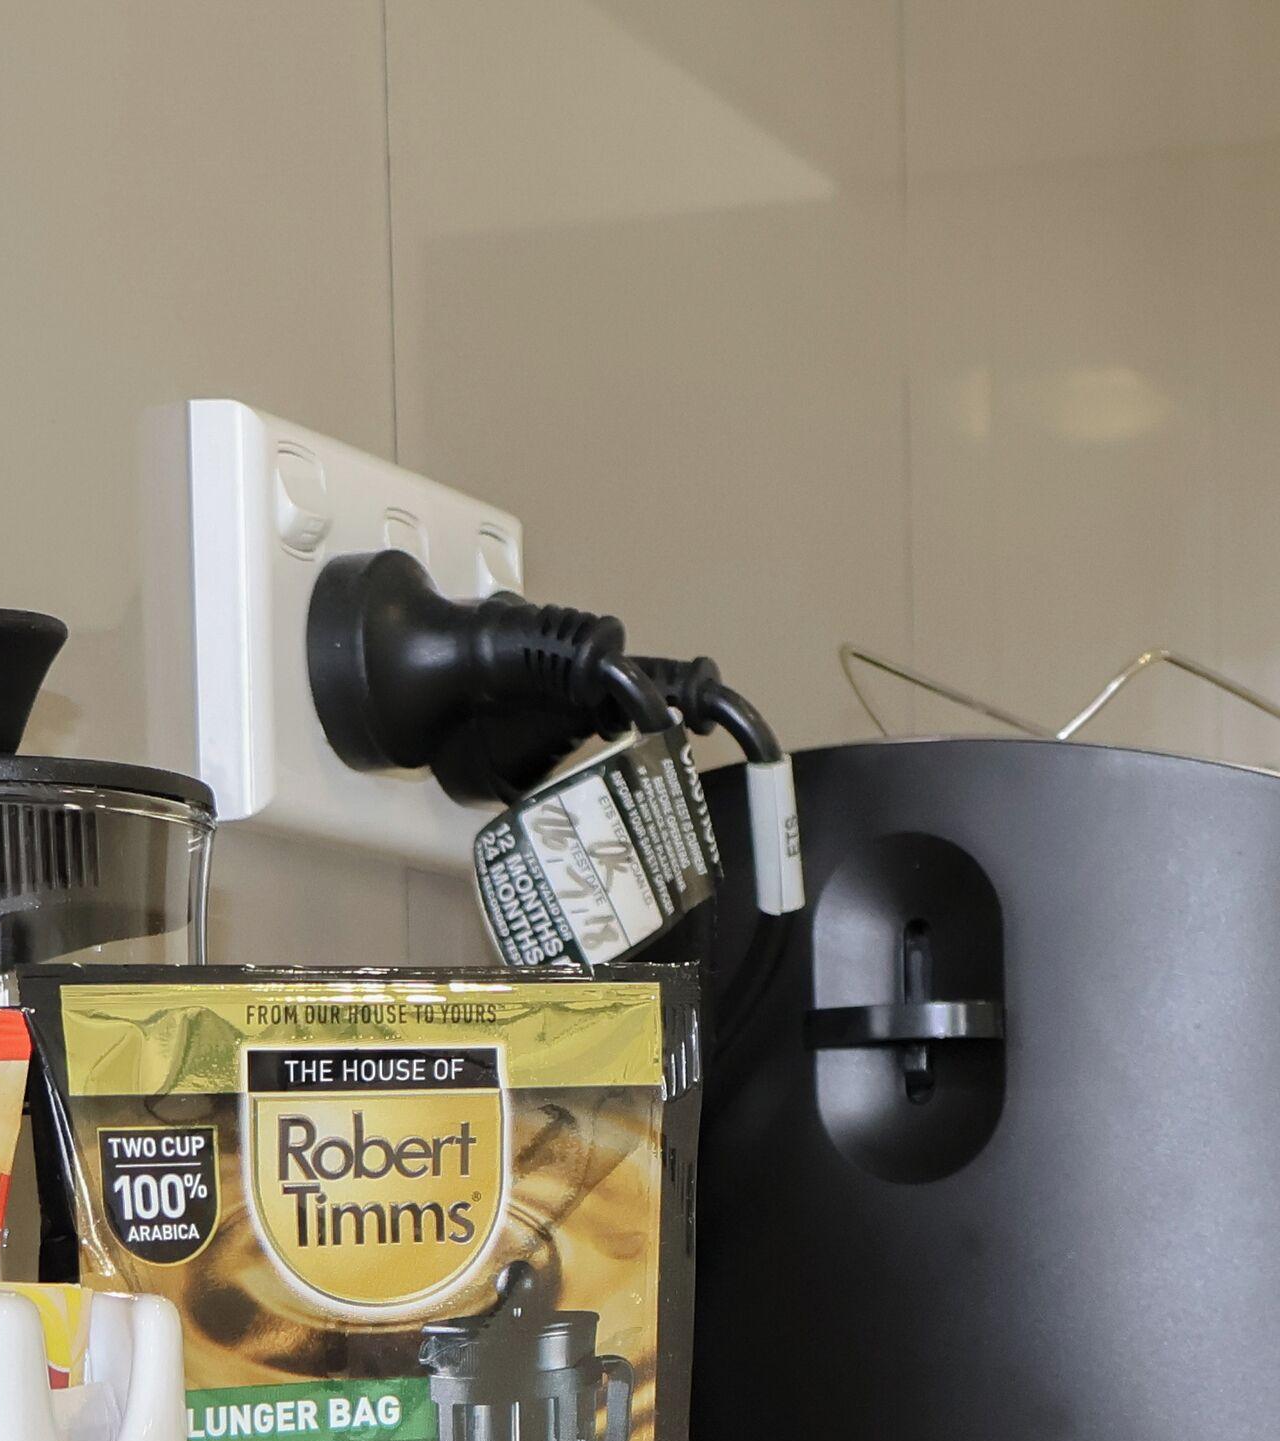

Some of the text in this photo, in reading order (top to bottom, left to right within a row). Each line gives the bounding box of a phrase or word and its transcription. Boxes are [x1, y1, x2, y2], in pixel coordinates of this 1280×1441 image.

[482, 831, 544, 965] 24 MONTHS
[495, 823, 564, 957] 12 MONTHS
[246, 1004, 298, 1025] FROM
[304, 1004, 341, 1025] OUR
[349, 1004, 407, 1025] HOUSE
[414, 1004, 434, 1024] TO
[284, 1058, 465, 1083] THE HOUSE OF
[107, 1135, 205, 1158] TWO CUP
[277, 1109, 477, 1181] Robert
[112, 1173, 208, 1220] 100%
[127, 1223, 200, 1242] ARABICA
[186, 1395, 401, 1438] LUNGER BAG
